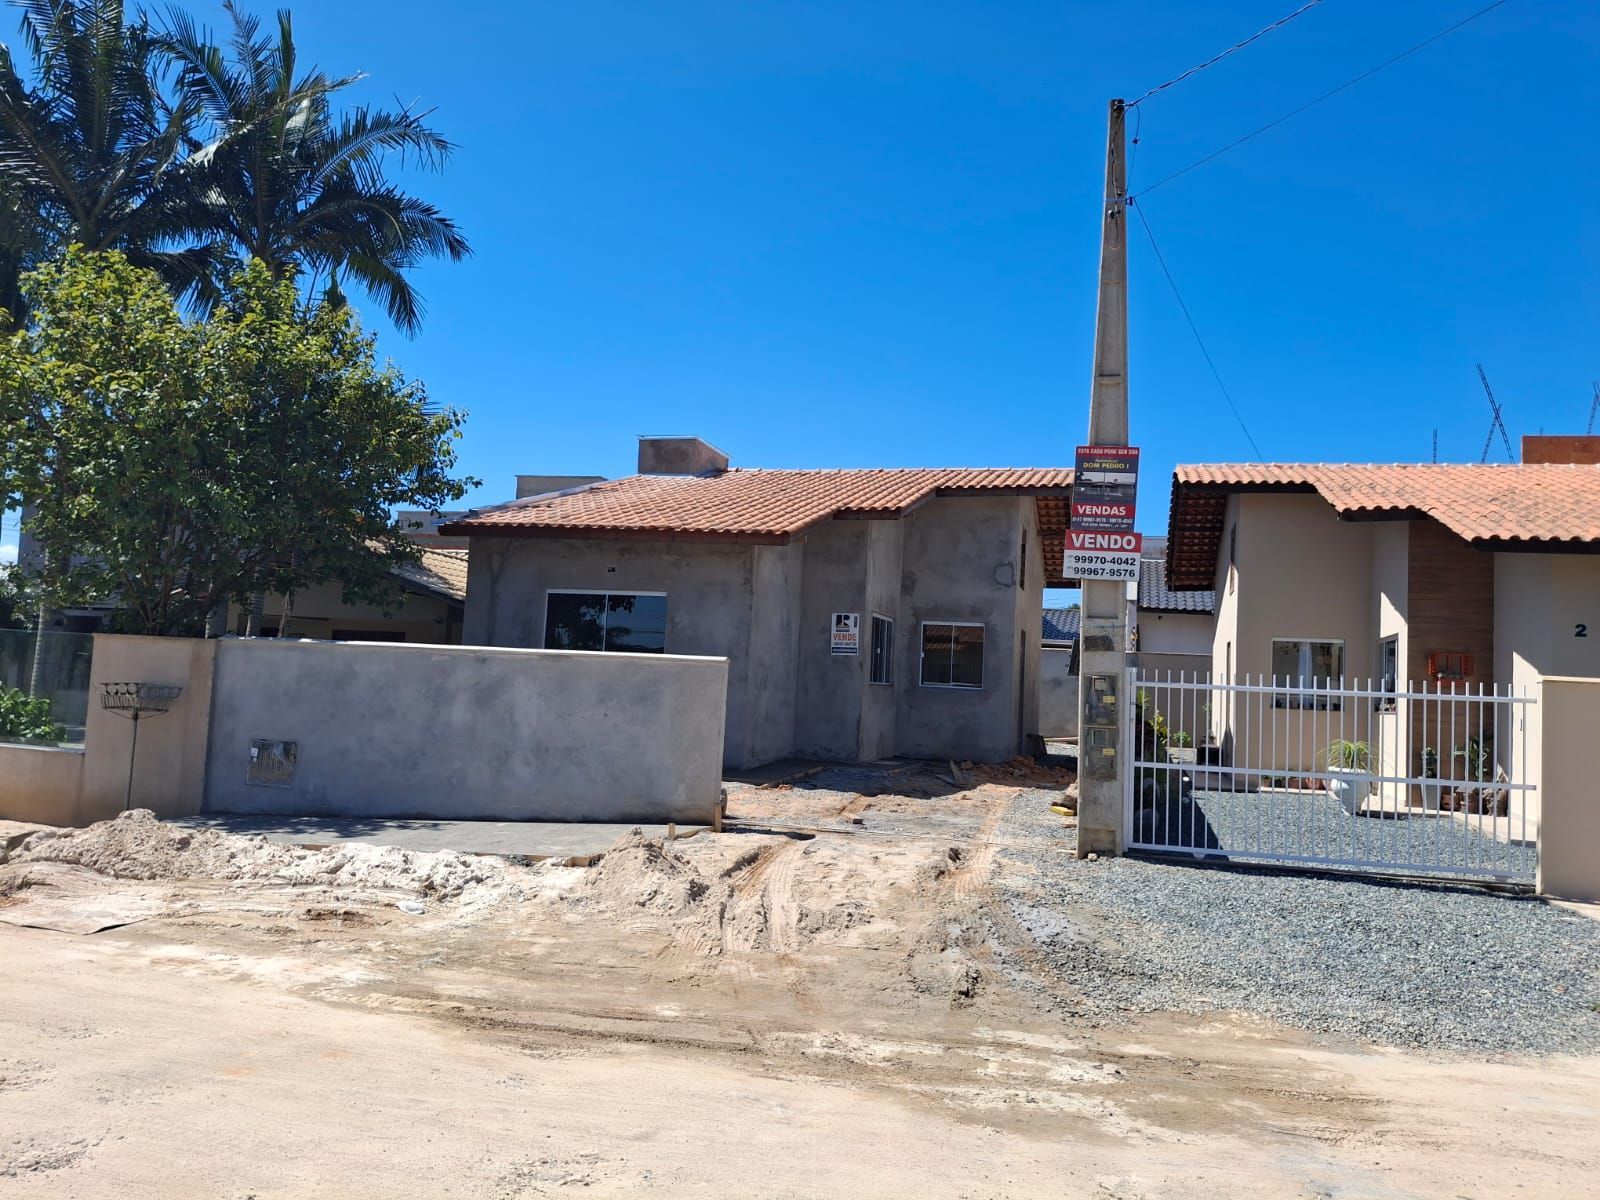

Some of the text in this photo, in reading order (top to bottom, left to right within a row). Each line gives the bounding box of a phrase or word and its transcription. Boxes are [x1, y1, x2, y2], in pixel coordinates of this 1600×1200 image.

[1077, 504, 1126, 516] VENDAS
[1071, 533, 1136, 550] VENDO
[1074, 555, 1136, 566] 99970-4042
[1073, 566, 1136, 578] 99967-9576
[1574, 623, 1587, 637] 2
[833, 633, 856, 641] VENDE
